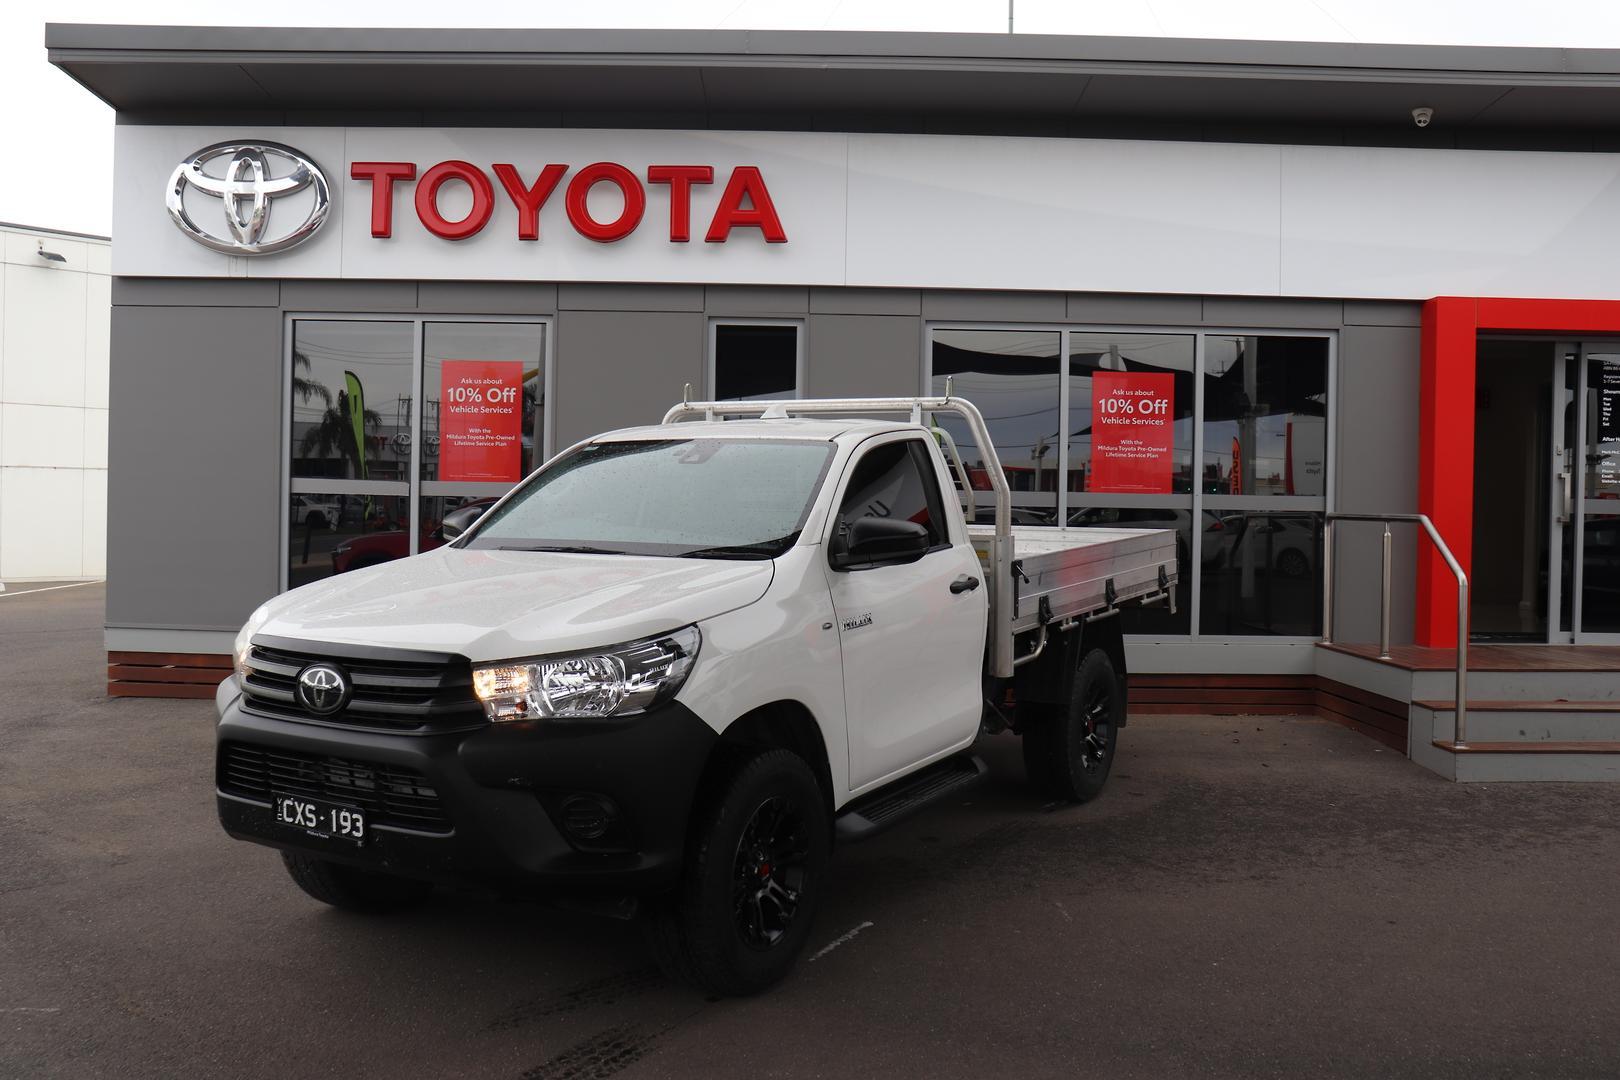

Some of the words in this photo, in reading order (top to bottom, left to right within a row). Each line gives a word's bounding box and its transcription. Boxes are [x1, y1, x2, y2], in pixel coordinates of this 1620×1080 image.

[350, 160, 788, 244] TOYOTA
[447, 387, 482, 403] 10%
[486, 387, 517, 403] Off
[449, 405, 479, 414] Vehicle
[1098, 398, 1134, 414] 10%
[1138, 399, 1168, 415] Off
[1101, 416, 1131, 425] Vehicle
